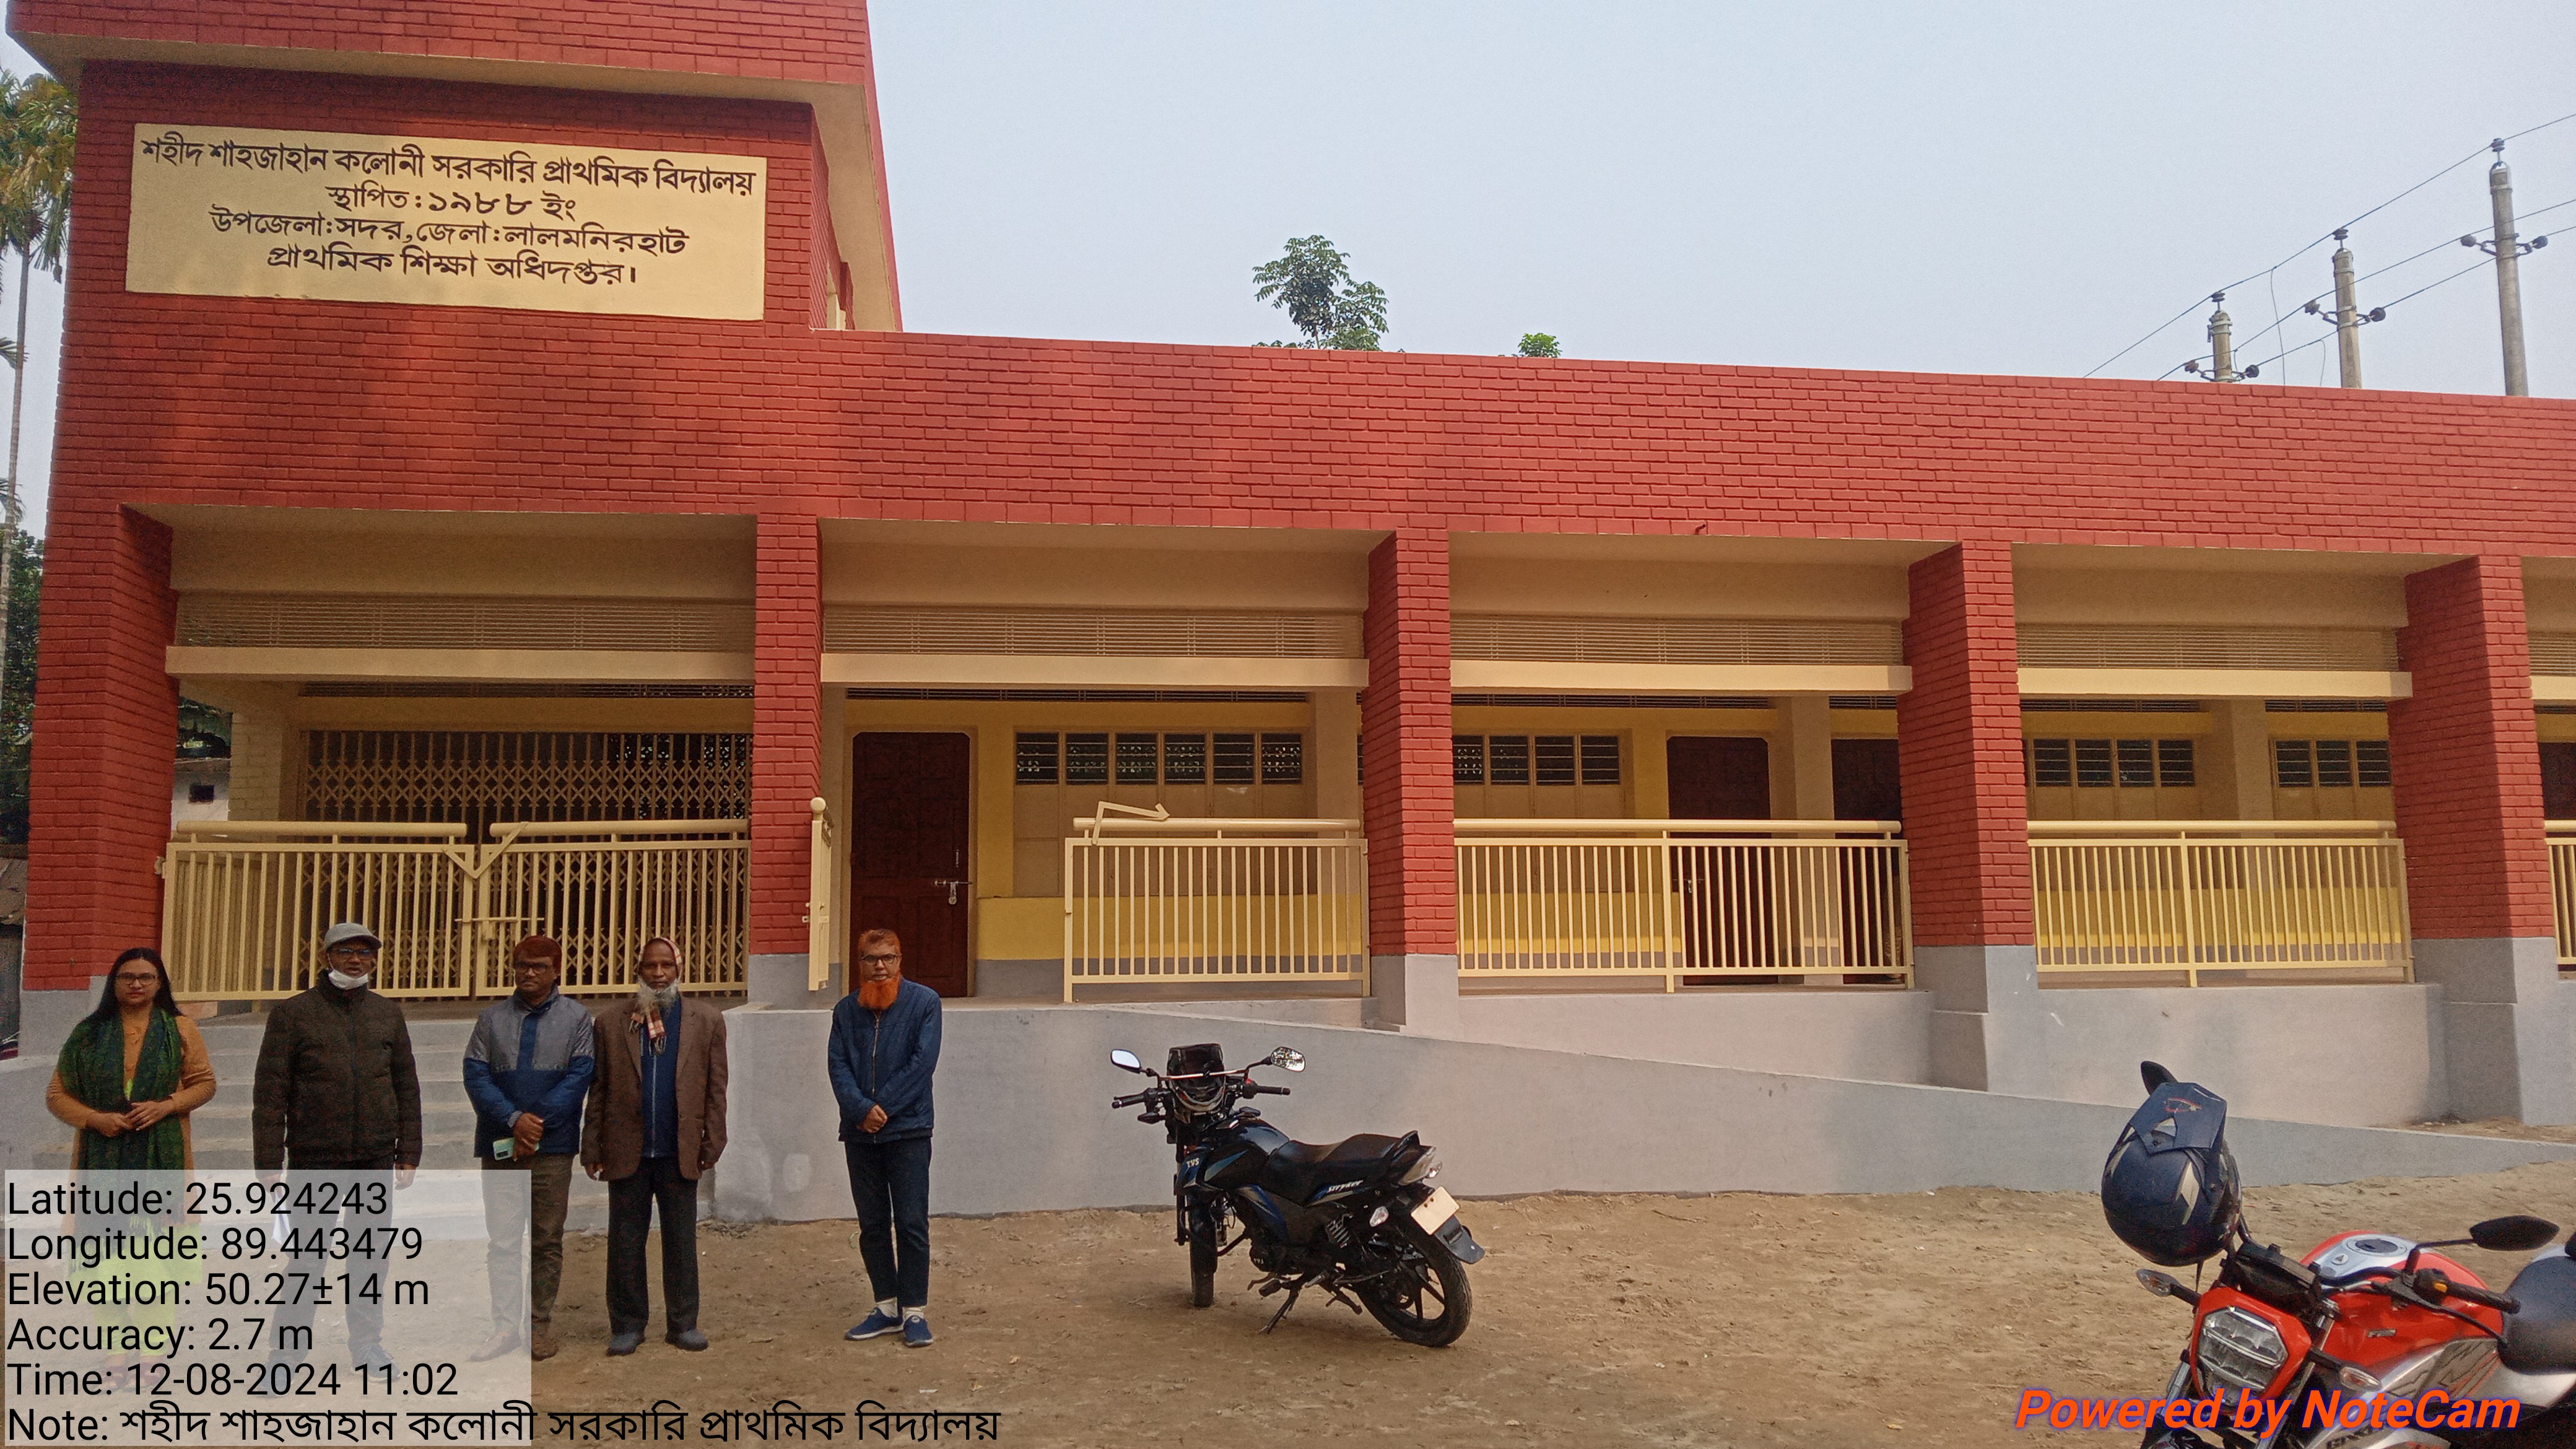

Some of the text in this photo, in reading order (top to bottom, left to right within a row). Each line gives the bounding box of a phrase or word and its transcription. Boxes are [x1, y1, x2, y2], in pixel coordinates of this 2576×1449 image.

[141, 131, 757, 196] শহীদ শাহজাহান কলোনী সরকারি প্রাথমিক বিদ্যালয়
[429, 191, 533, 215] ১৯৮৮
[541, 190, 576, 222] ইং
[268, 241, 394, 272] প্রাথমিক
[399, 245, 478, 277] শিক্ষা
[1186, 1157, 1199, 1168] TVS
